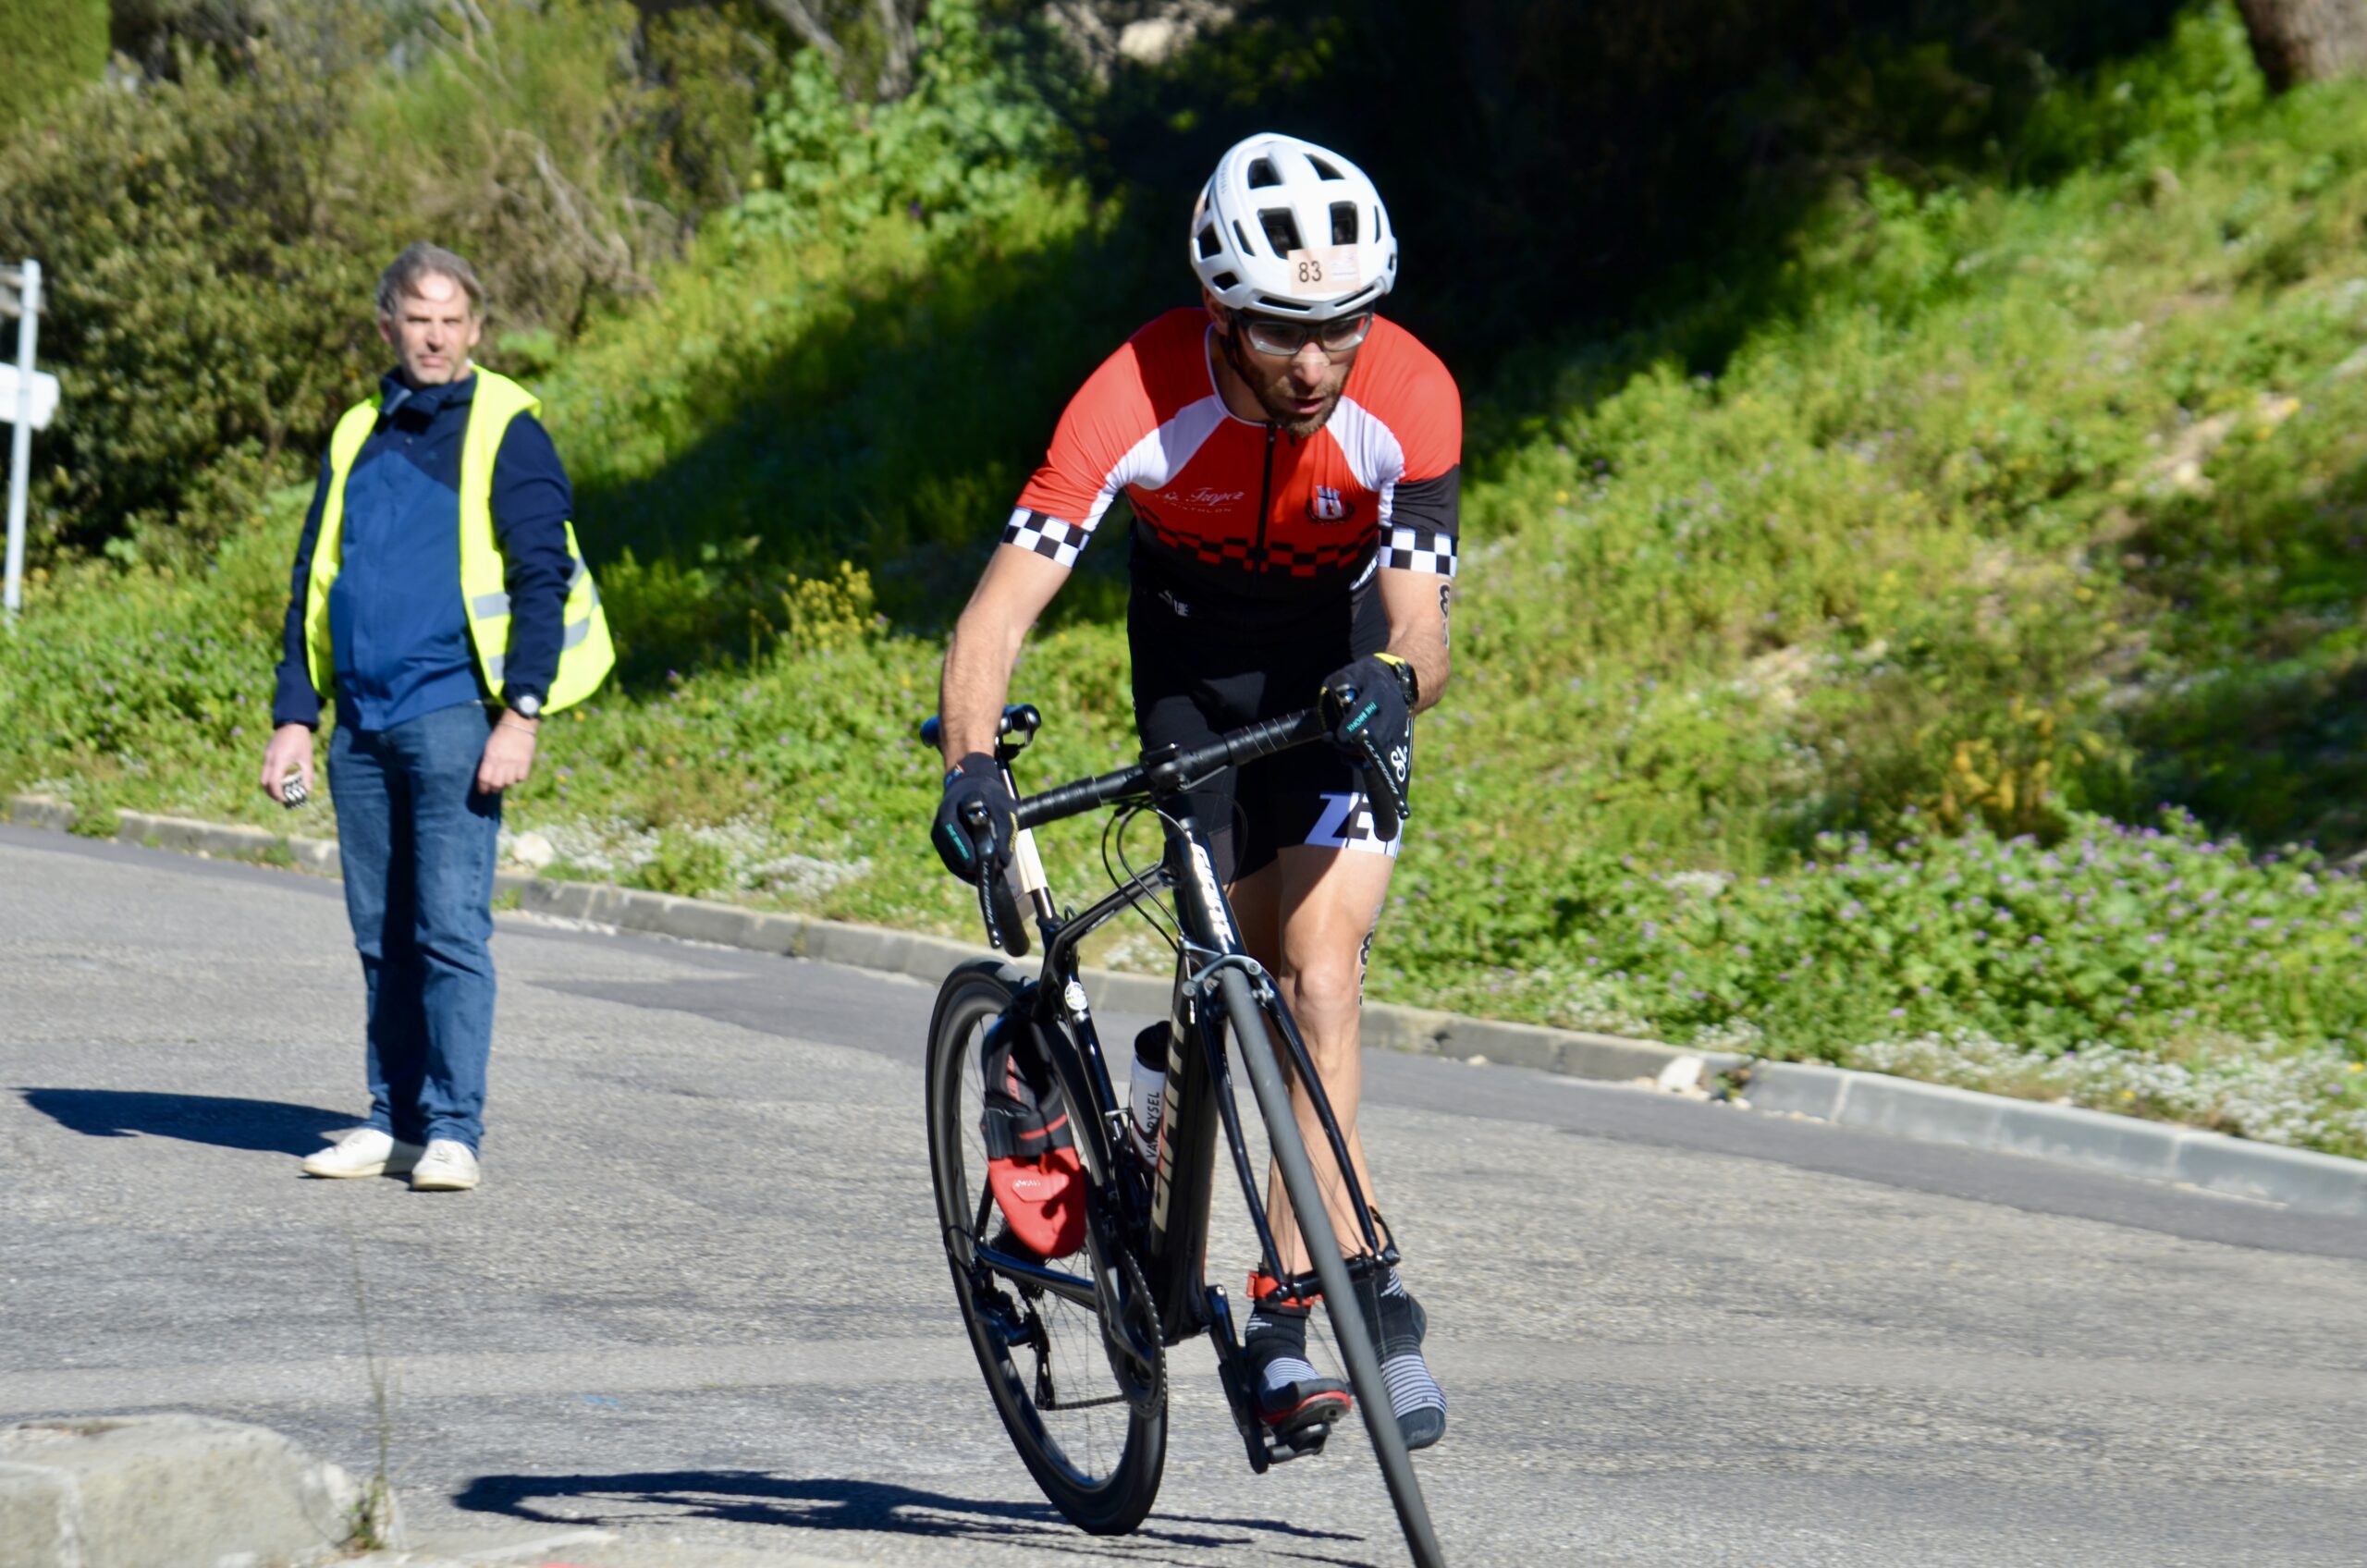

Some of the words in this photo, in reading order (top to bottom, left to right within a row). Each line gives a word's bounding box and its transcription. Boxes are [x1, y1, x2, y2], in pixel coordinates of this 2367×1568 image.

[1298, 260, 1322, 283] 83
[1346, 710, 1368, 733] BRONX
[1364, 740, 1399, 795] ULTEGRA
[983, 861, 995, 925] ULTEGRA
